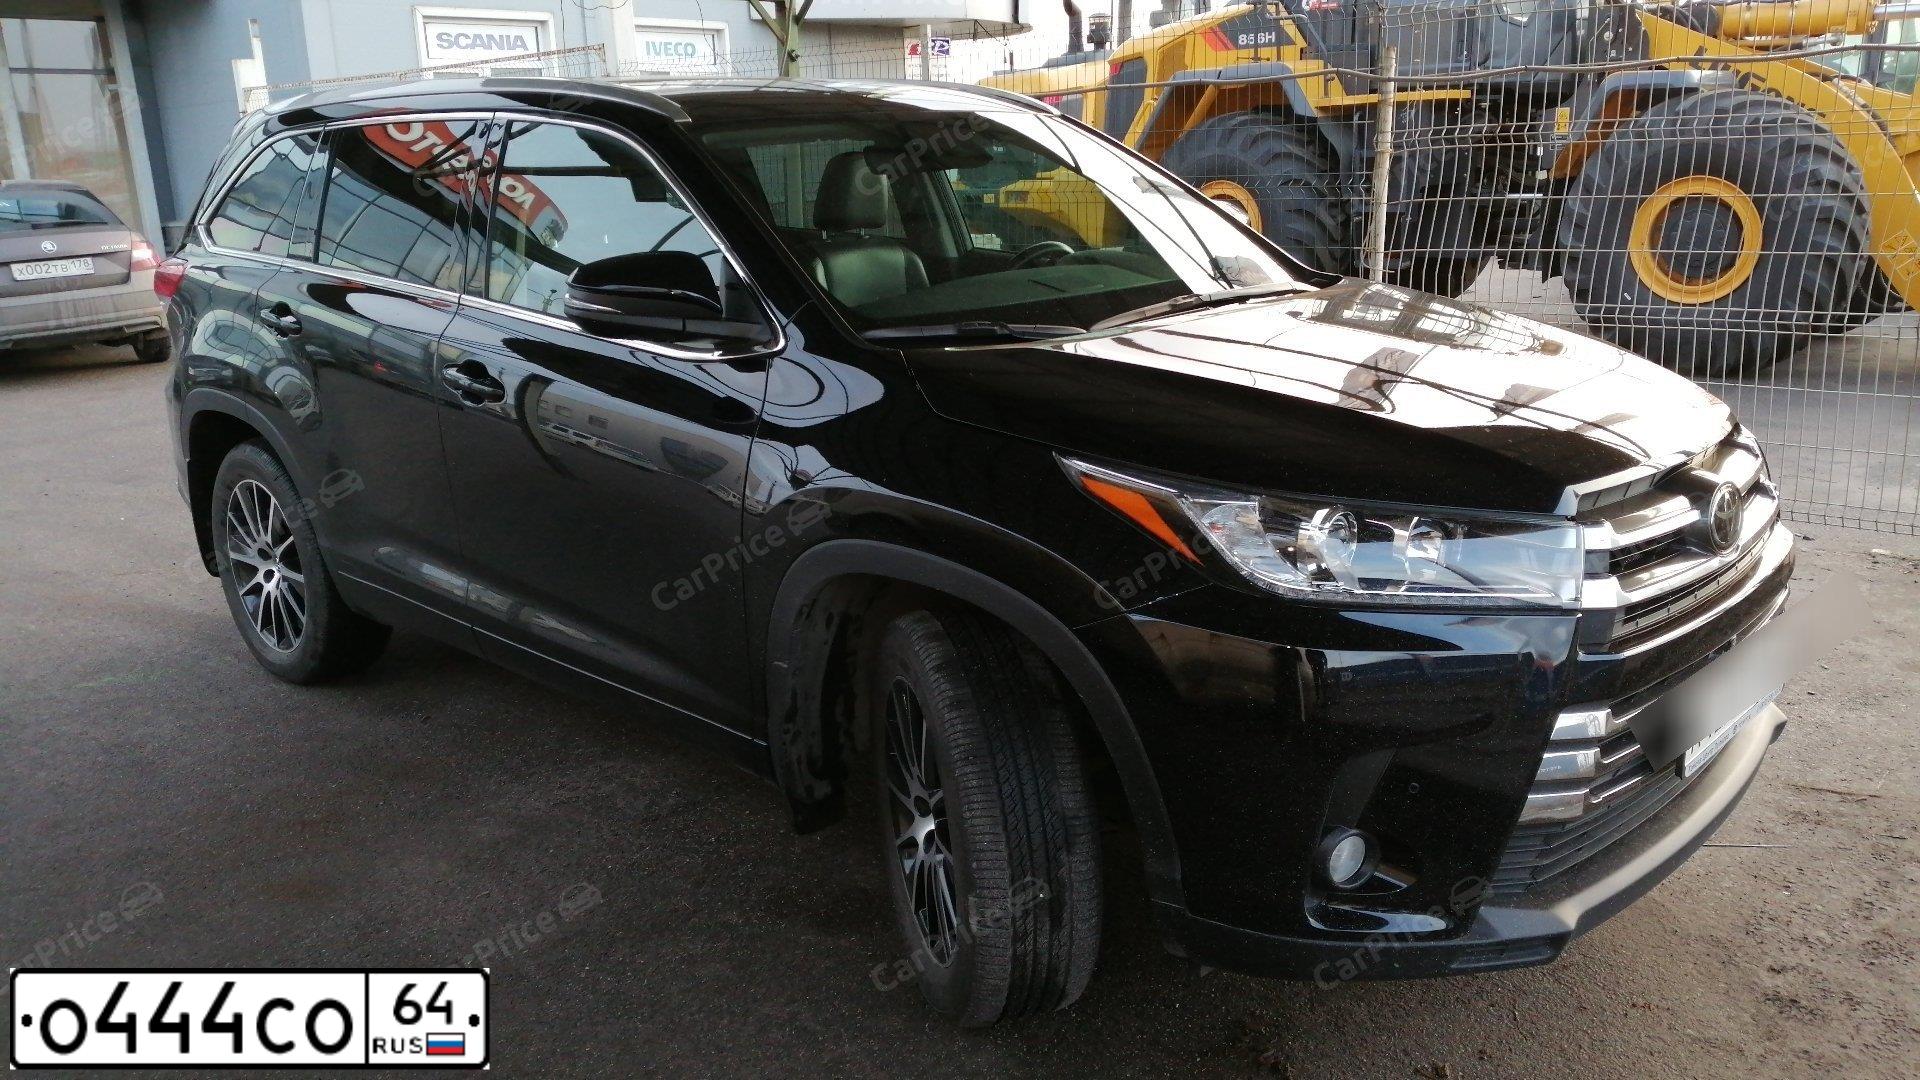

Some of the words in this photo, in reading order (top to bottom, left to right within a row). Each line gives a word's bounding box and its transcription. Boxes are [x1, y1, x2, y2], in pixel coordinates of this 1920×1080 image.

[436, 32, 529, 51] SCANIA
[644, 41, 696, 57] IVECO
[71, 258, 90, 269] 178
